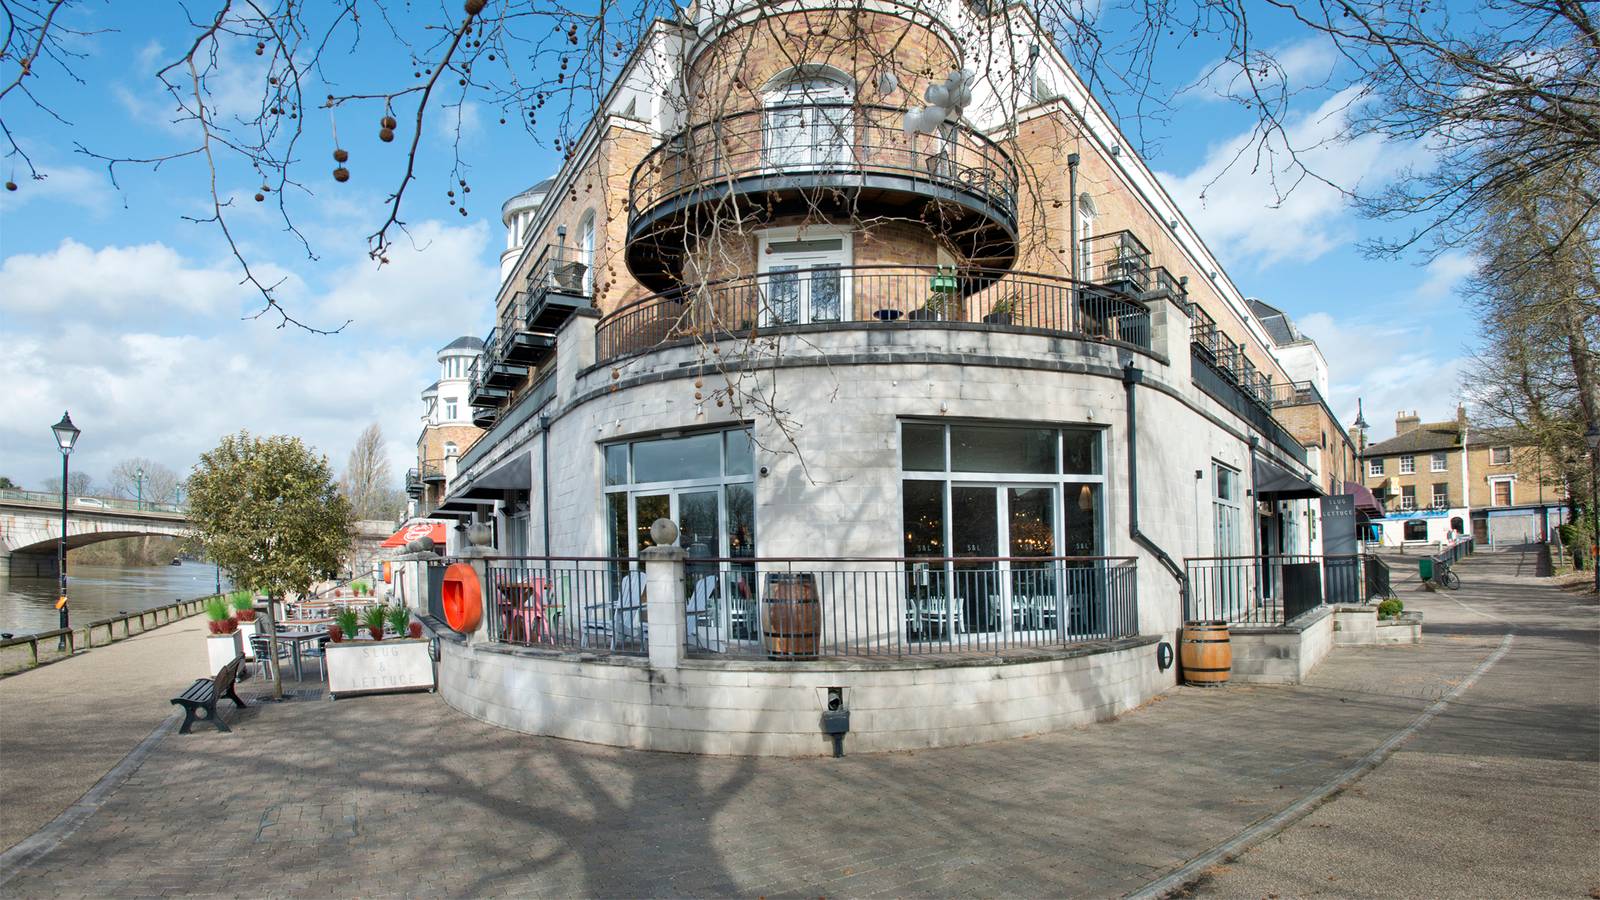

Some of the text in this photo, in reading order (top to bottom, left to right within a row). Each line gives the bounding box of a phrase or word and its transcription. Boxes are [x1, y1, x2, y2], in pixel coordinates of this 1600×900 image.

[362, 646, 399, 657] SLUG
[379, 662, 385, 673] &
[352, 674, 416, 688] LETTUCE
